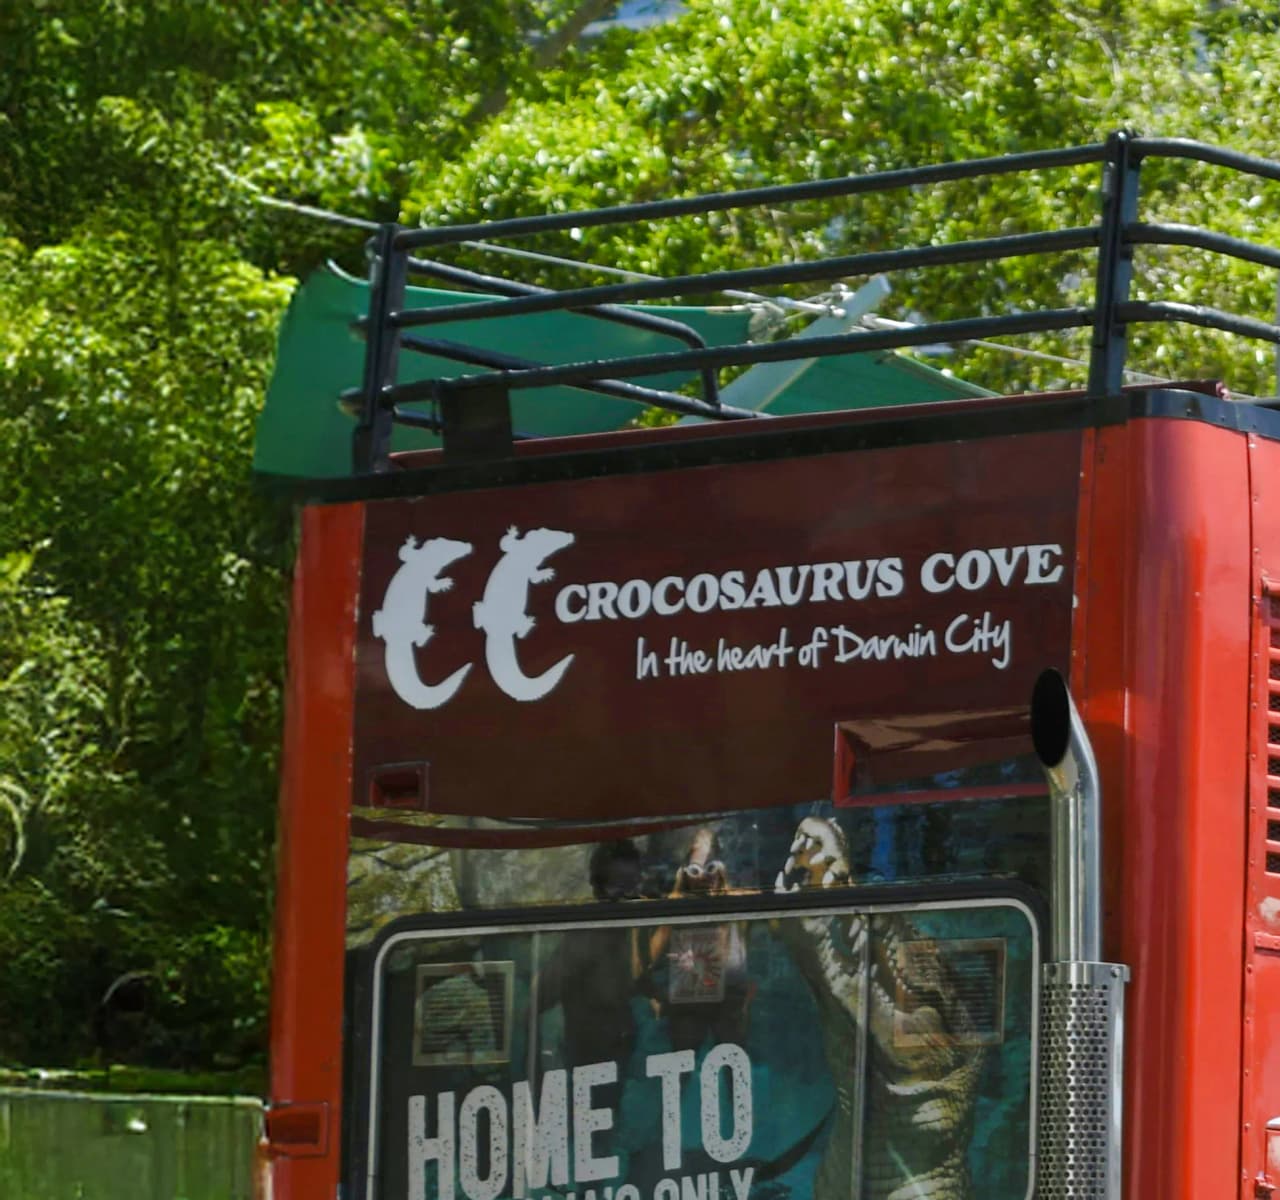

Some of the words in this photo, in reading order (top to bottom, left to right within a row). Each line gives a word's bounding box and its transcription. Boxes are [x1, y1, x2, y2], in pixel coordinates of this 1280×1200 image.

[555, 557, 904, 623] CROCOSAURUS
[920, 543, 1064, 594] COVE
[636, 637, 659, 680] In
[664, 636, 713, 675] the
[717, 627, 793, 672] heart
[798, 626, 829, 668] of
[830, 623, 937, 663] Darwin
[945, 611, 1013, 669] City
[645, 1043, 753, 1171] TO
